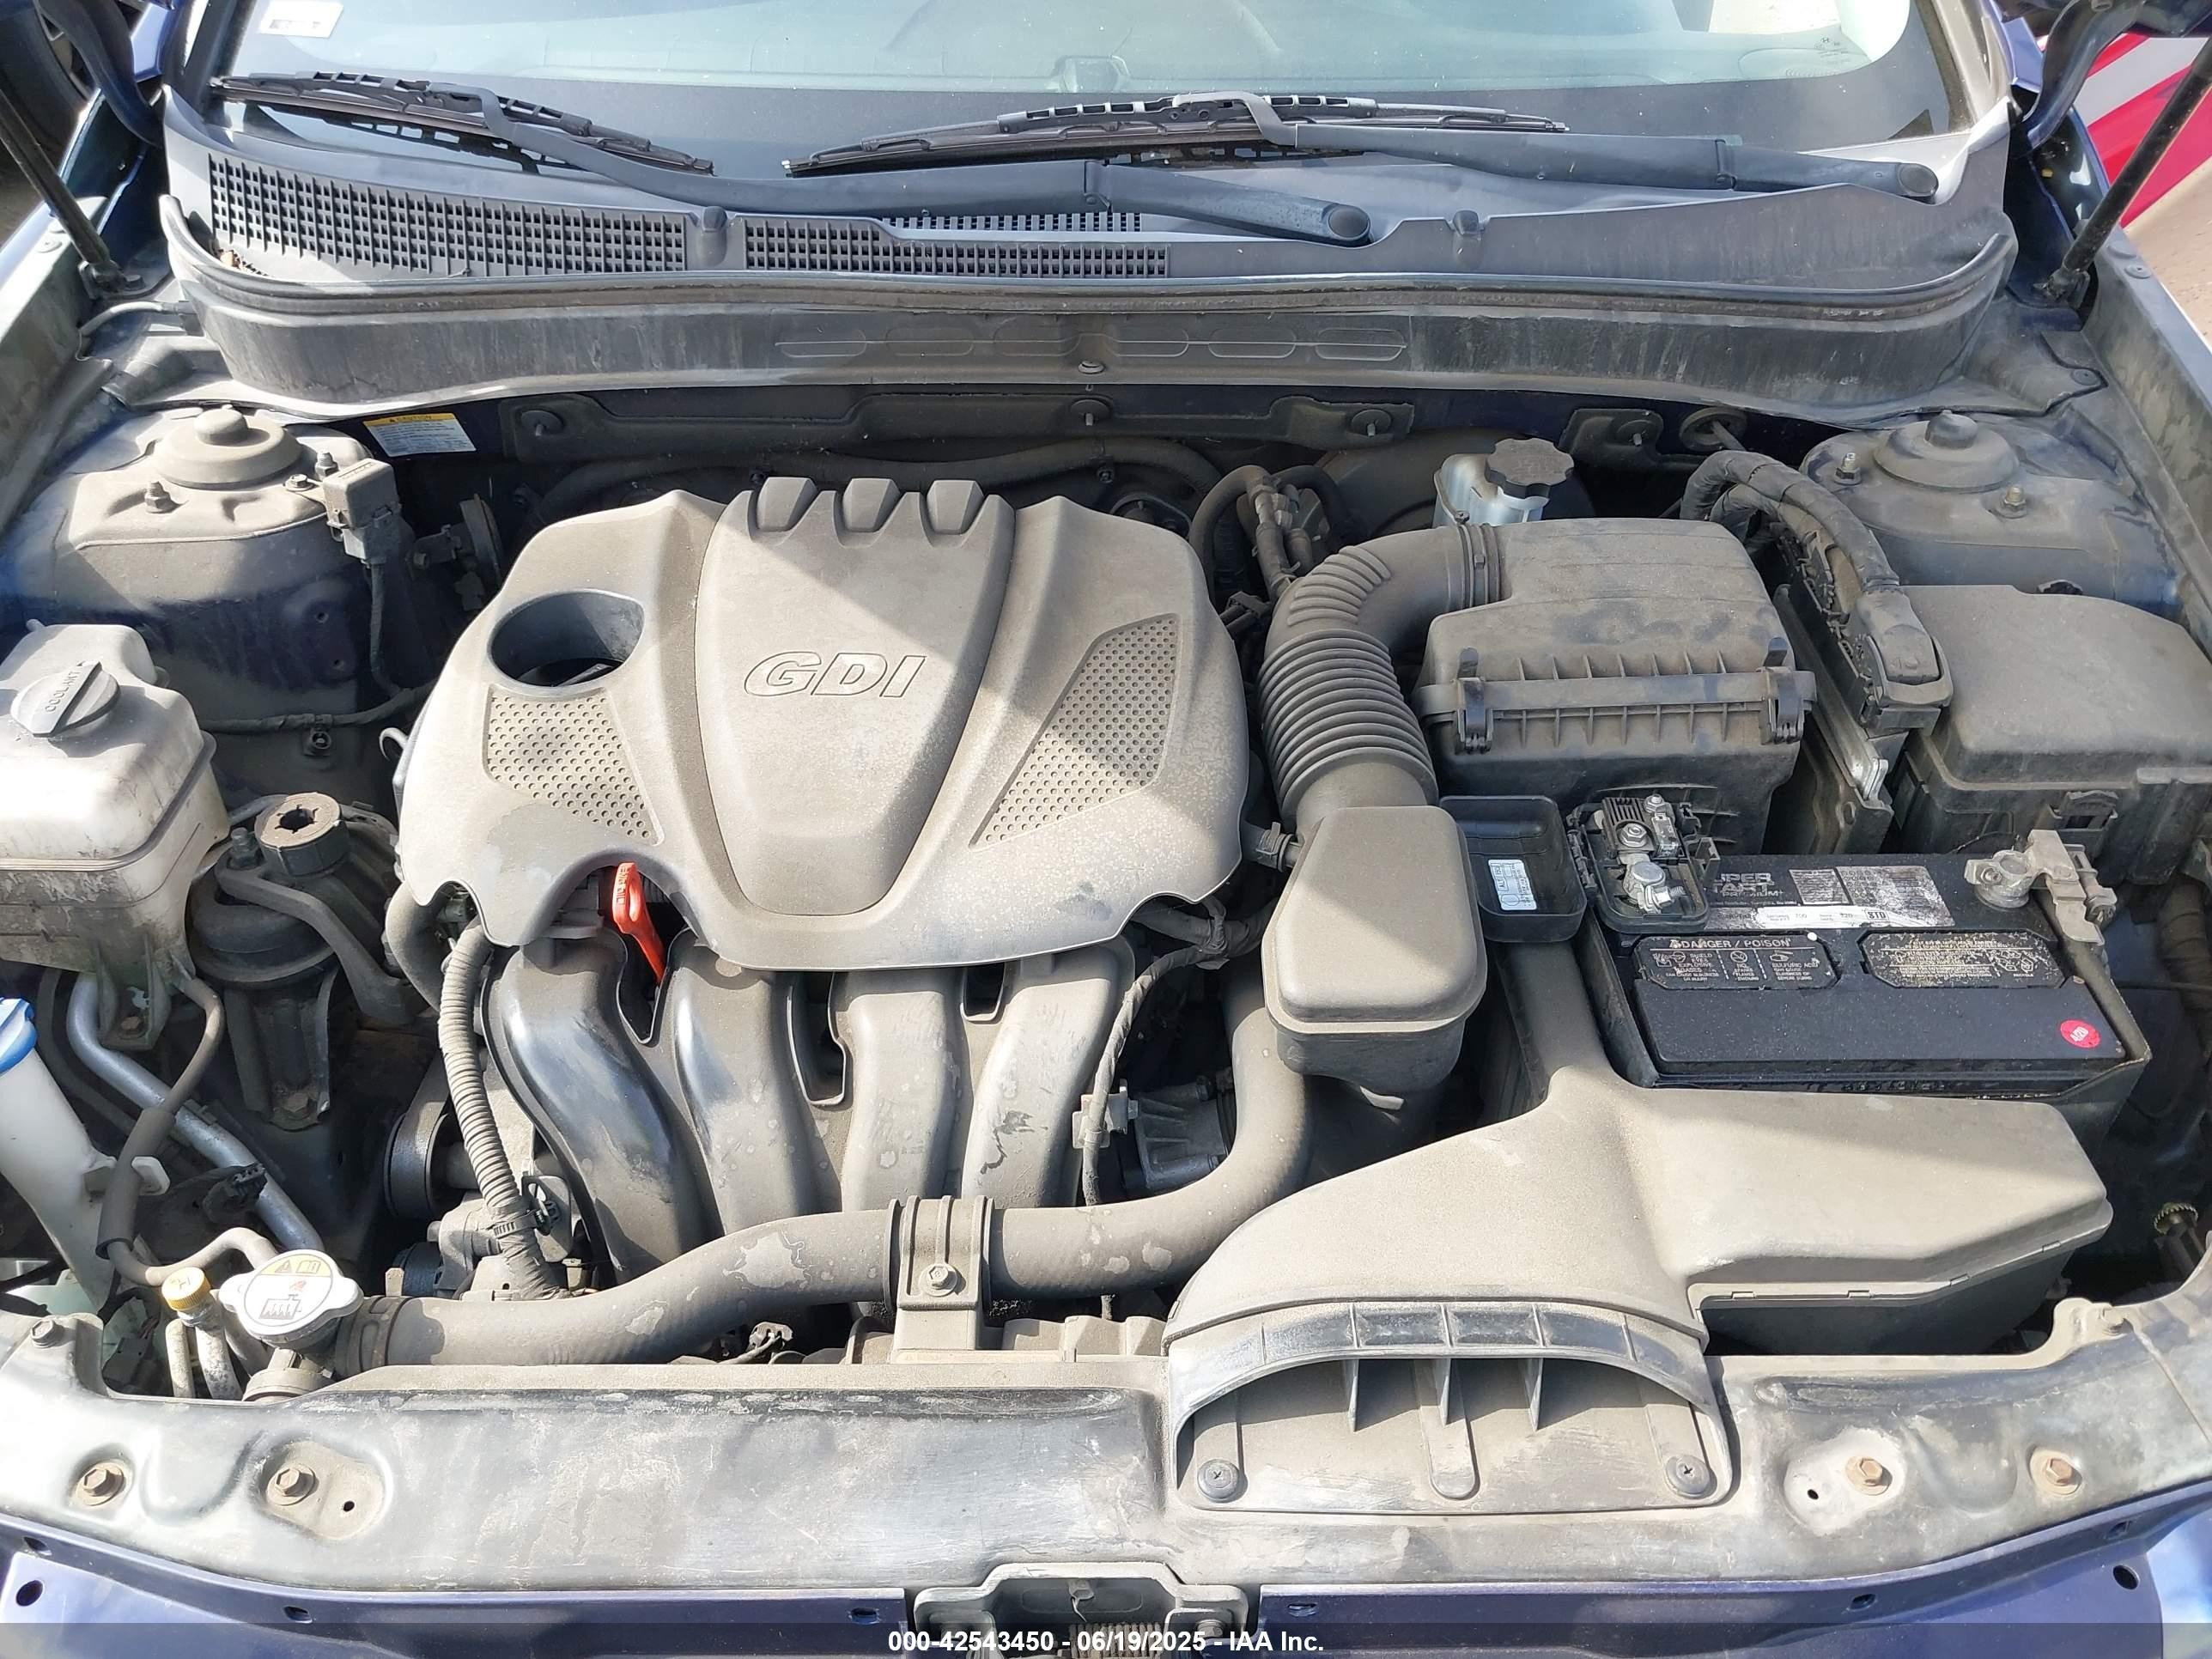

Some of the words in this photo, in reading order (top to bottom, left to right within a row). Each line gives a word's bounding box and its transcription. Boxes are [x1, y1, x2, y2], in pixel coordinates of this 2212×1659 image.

[46, 670, 82, 714] COOLANT
[744, 650, 927, 698] GDI
[1680, 939, 1731, 949] DANGER
[1744, 939, 1790, 948] POISON
